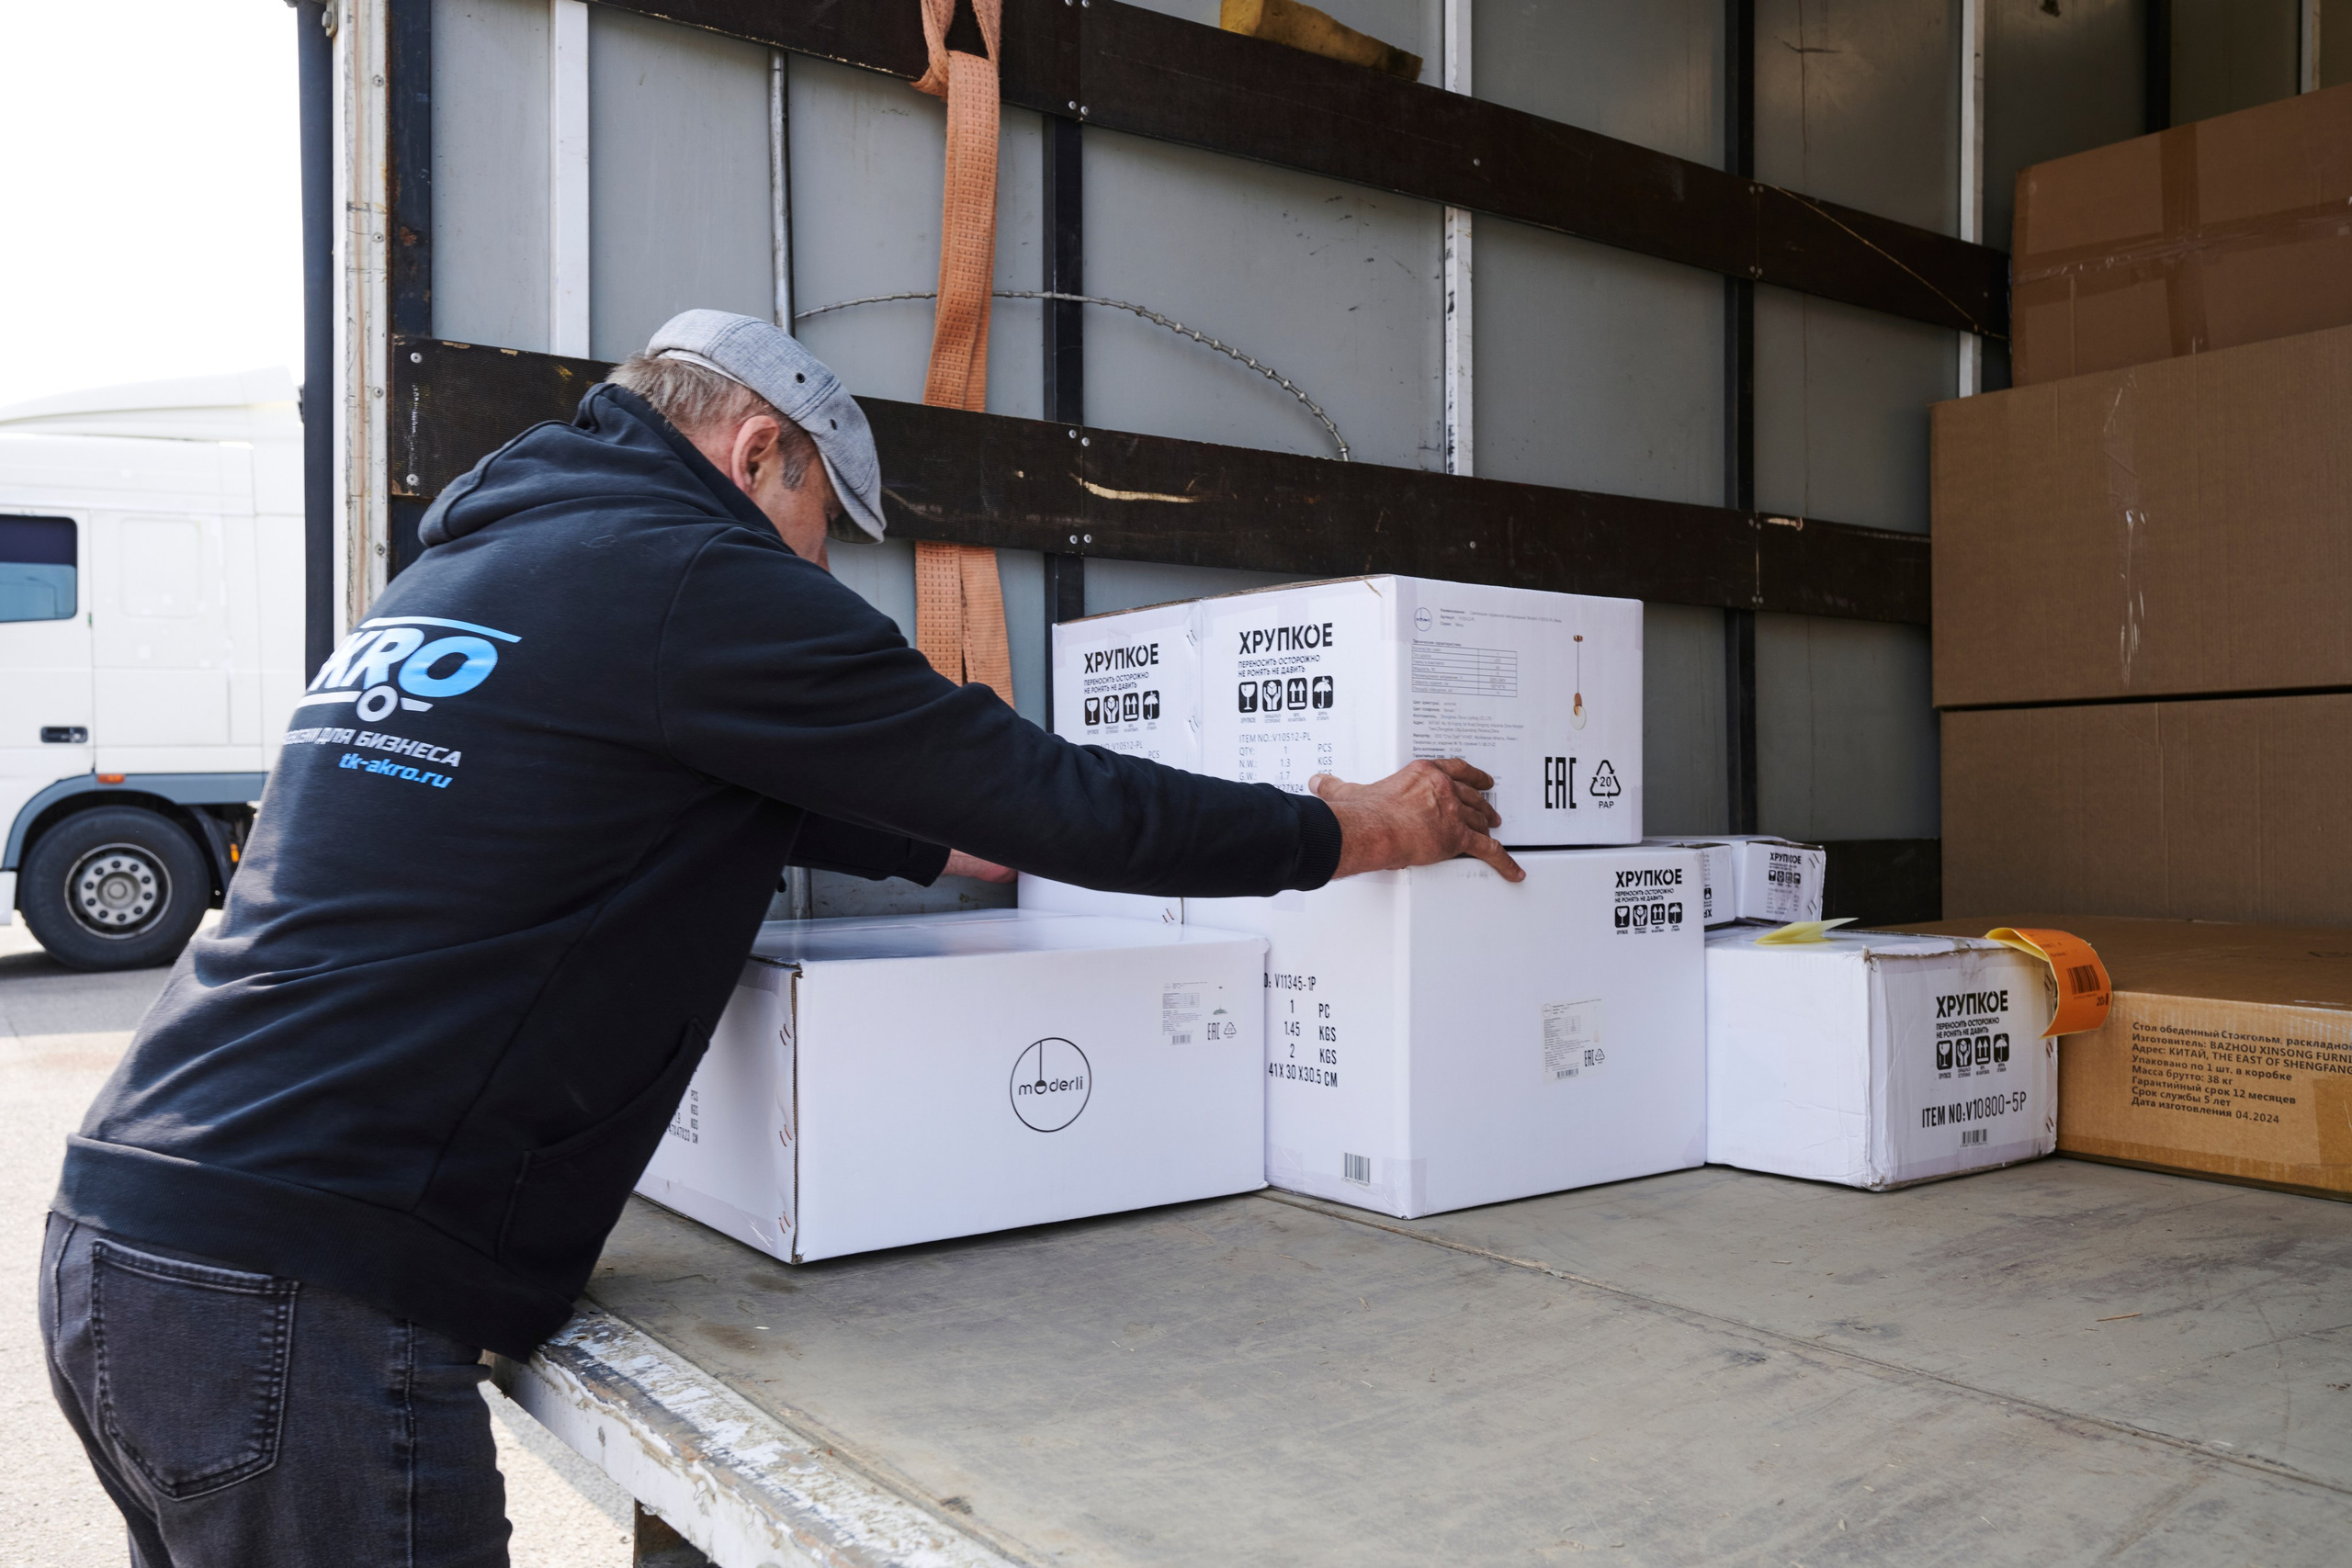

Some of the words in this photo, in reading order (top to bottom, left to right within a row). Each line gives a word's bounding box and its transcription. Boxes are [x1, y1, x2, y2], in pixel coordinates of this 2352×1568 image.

[1239, 623, 1333, 655] ХРУПКОЕ
[307, 628, 498, 697] KRO
[1084, 643, 1159, 673] ХРУПКОЕ
[1238, 659, 1276, 668] ПЕРЕНОСИТЬ
[1278, 654, 1320, 665] ОСТОРОЖНО
[1084, 676, 1114, 686] ПЕРЕНОСИТЬ
[1116, 671, 1148, 682] ОСТОРОЖНО
[1247, 668, 1270, 676] РОНЯТЬ
[1272, 667, 1279, 675] НЕ
[1281, 665, 1306, 675] ДАВИТЬ
[1118, 682, 1137, 691] ДАВИТЬ
[1239, 734, 1256, 743] ITEM
[354, 731, 461, 767] БИЗНЕСА
[1148, 750, 1159, 759] PCS
[1239, 747, 1255, 756] QTY:
[1317, 743, 1332, 752] PCS
[1317, 756, 1332, 765] KGS
[339, 753, 453, 788] tk-akro.ru
[1600, 776, 1611, 787] 20
[1615, 869, 1682, 888] ХРУПКОЕ
[1290, 999, 1295, 1013] 1
[1318, 1003, 1330, 1019] PC
[1936, 990, 2008, 1019] ХРУПКОЕ
[1284, 1021, 1300, 1036] 1.45
[1319, 1026, 1337, 1042] KGS
[1936, 1021, 1966, 1030] ПЕРЕНОСИТЬ
[1968, 1017, 1999, 1027] ОСТОРОЖНО
[1936, 1031, 1942, 1039] НЕ
[1943, 1030, 1962, 1038] РОНЯТЬ
[1970, 1026, 1989, 1035] ДАВИТЬ
[2132, 1021, 2157, 1032] Стол
[2160, 1025, 2219, 1038] обеденный
[1290, 1043, 1295, 1058] 2
[1319, 1048, 1337, 1065] KGS
[2132, 1033, 2206, 1047] Изготовитель:
[2210, 1041, 2256, 1054] BAZHOU
[2260, 1046, 2313, 1059] XINSONG
[2132, 1043, 2165, 1055] Адрес:
[2169, 1048, 2209, 1060] КИТАЙ,
[2212, 1052, 2233, 1062] THE
[2236, 1055, 2262, 1065] EAST
[2266, 1057, 2280, 1066] OF
[2132, 1055, 2188, 1068] Упаковано
[2245, 1068, 2292, 1081] коробке
[2132, 1066, 2164, 1077] Масса
[2166, 1069, 2204, 1081] брутто:
[2207, 1075, 2220, 1084] 38
[1018, 1076, 1083, 1095] moderli
[1324, 1071, 1338, 1088] CM
[2132, 1076, 2201, 1092] Гарантийный
[2205, 1086, 2230, 1096] срок
[2233, 1089, 2245, 1098] 12
[2248, 1092, 2296, 1105] месяцев
[2132, 1086, 2157, 1097] Срок
[2160, 1091, 2201, 1102] службы
[2204, 1095, 2211, 1104] 5
[2213, 1098, 2232, 1106] лет
[1922, 1105, 1945, 1128] ITEM
[2132, 1097, 2156, 1107] Дата
[2159, 1101, 2233, 1117] изготовления
[2235, 1110, 2279, 1123] 04.2024
